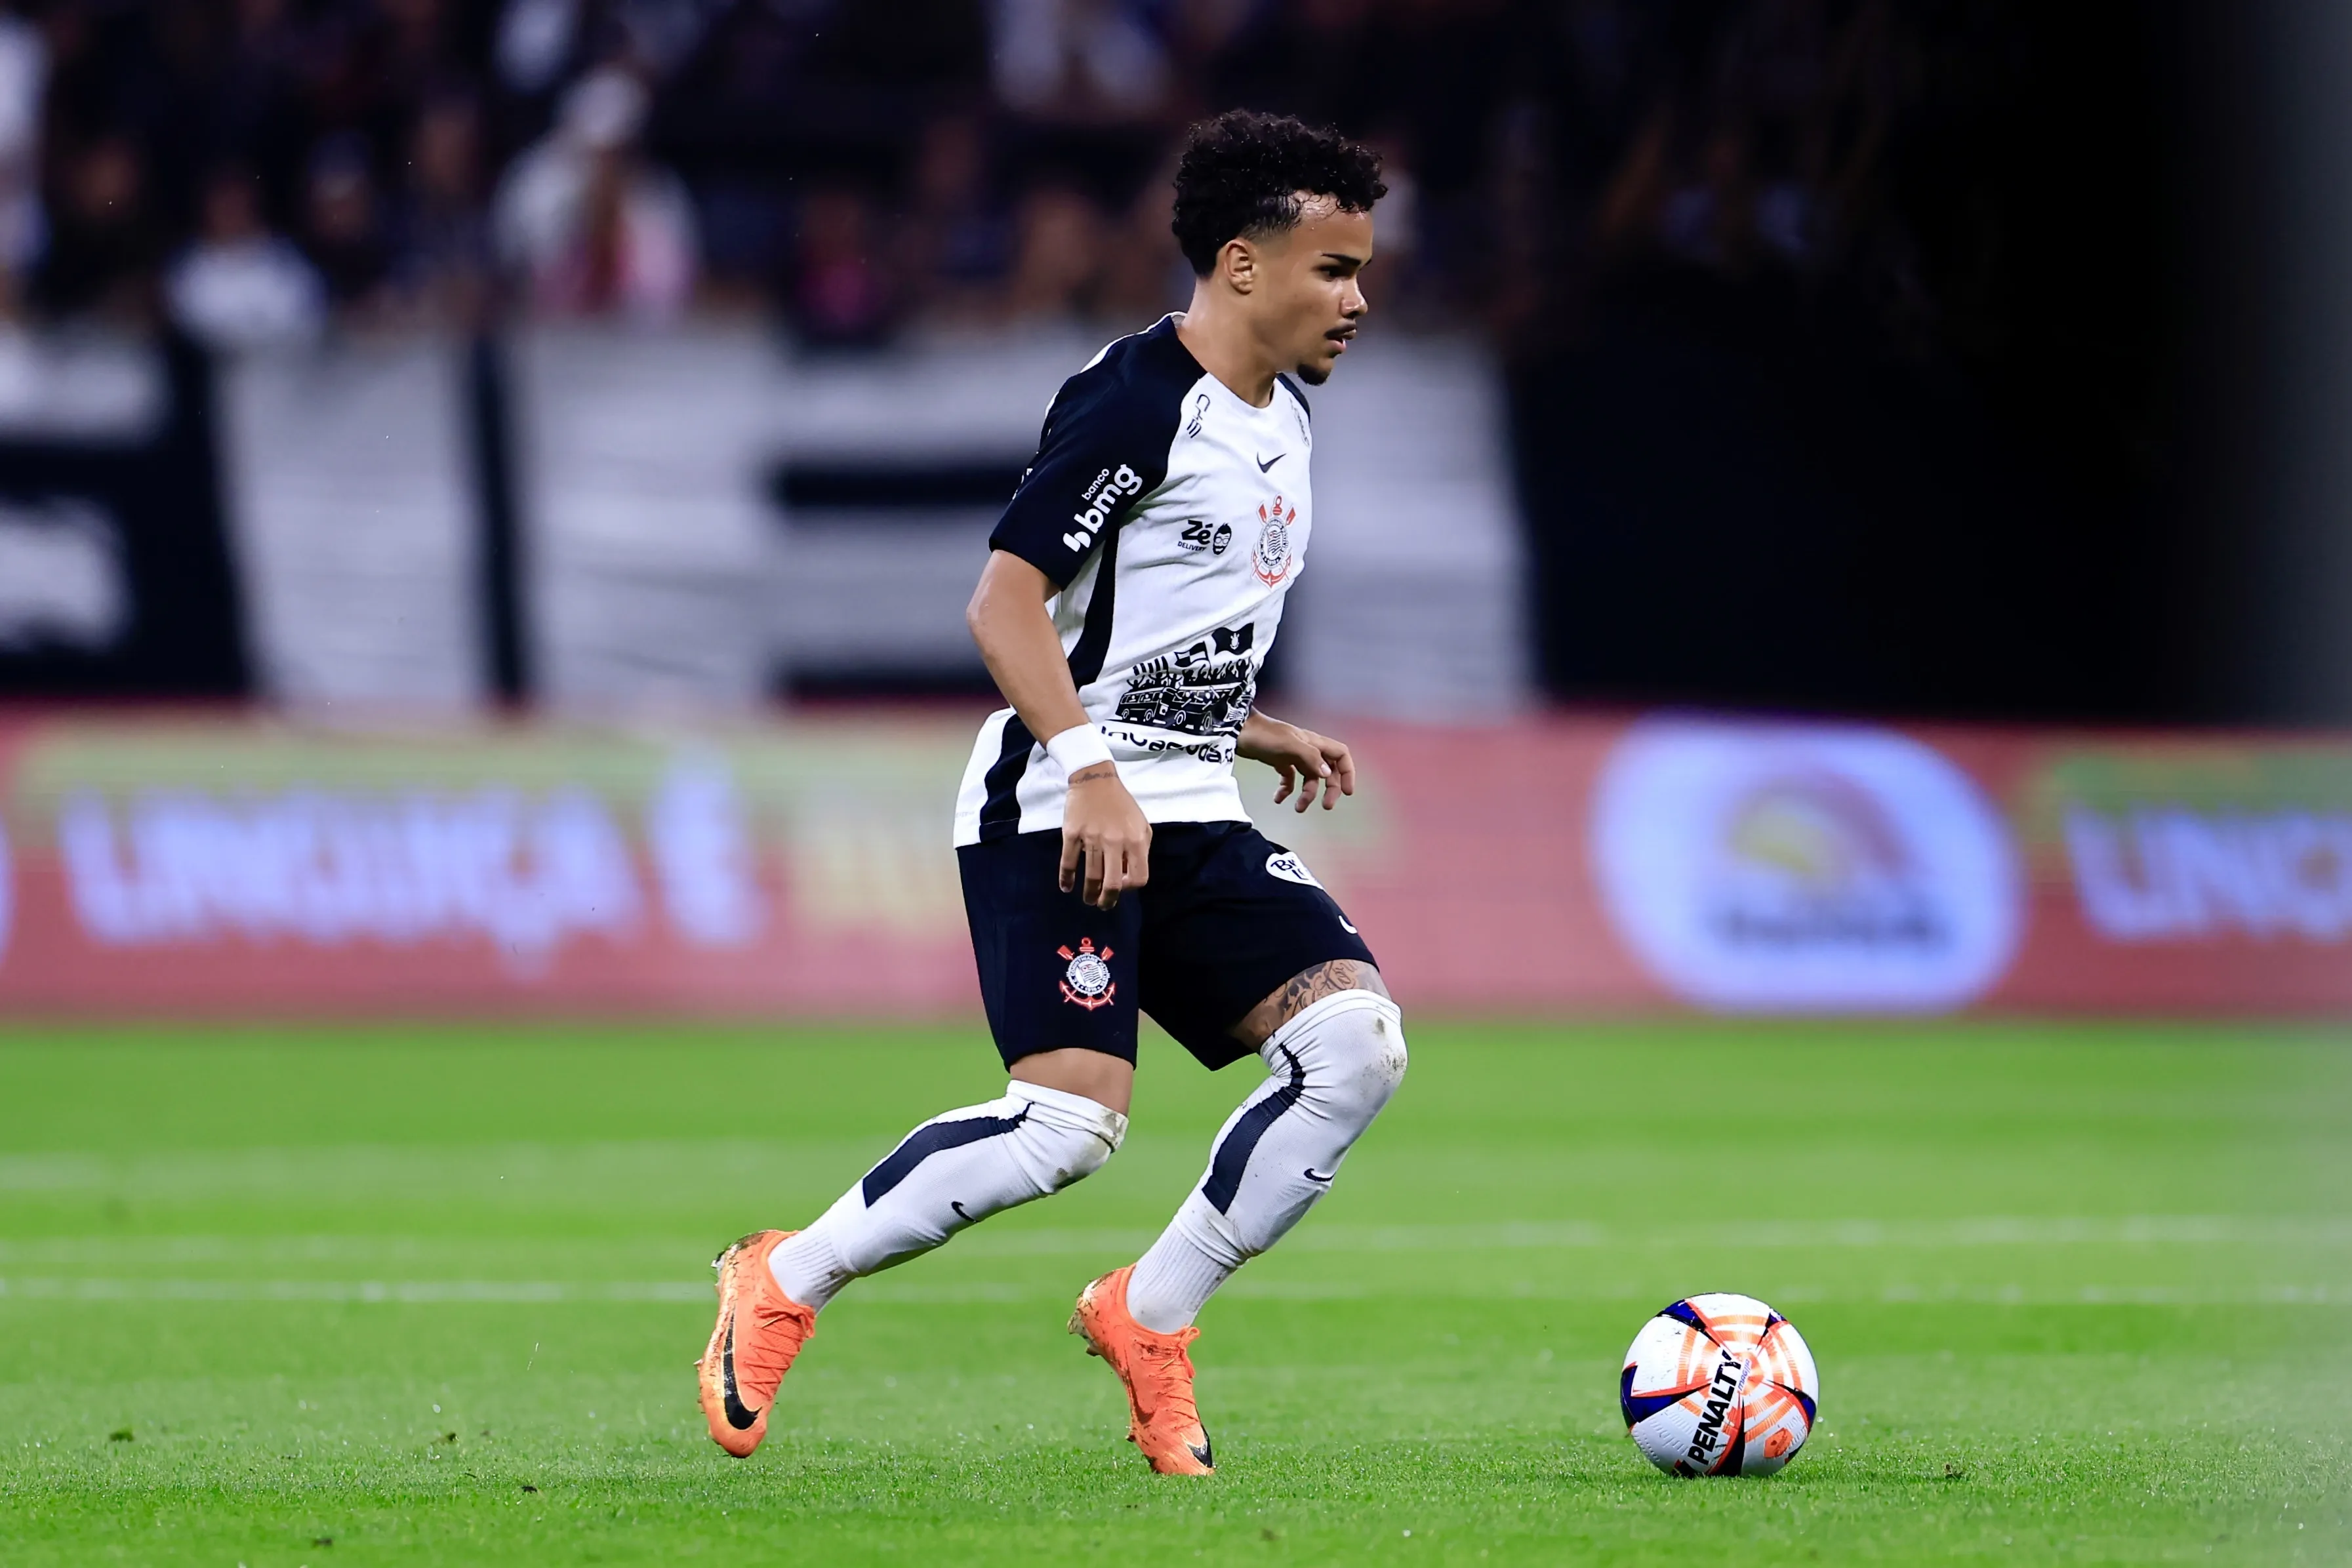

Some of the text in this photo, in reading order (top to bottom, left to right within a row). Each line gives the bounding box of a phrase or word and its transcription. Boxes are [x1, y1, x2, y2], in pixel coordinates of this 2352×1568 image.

[1074, 464, 1143, 534] bmg
[1082, 468, 1110, 500] banco
[1181, 519, 1213, 545] Zé
[1688, 1349, 1742, 1466] PENALTY
